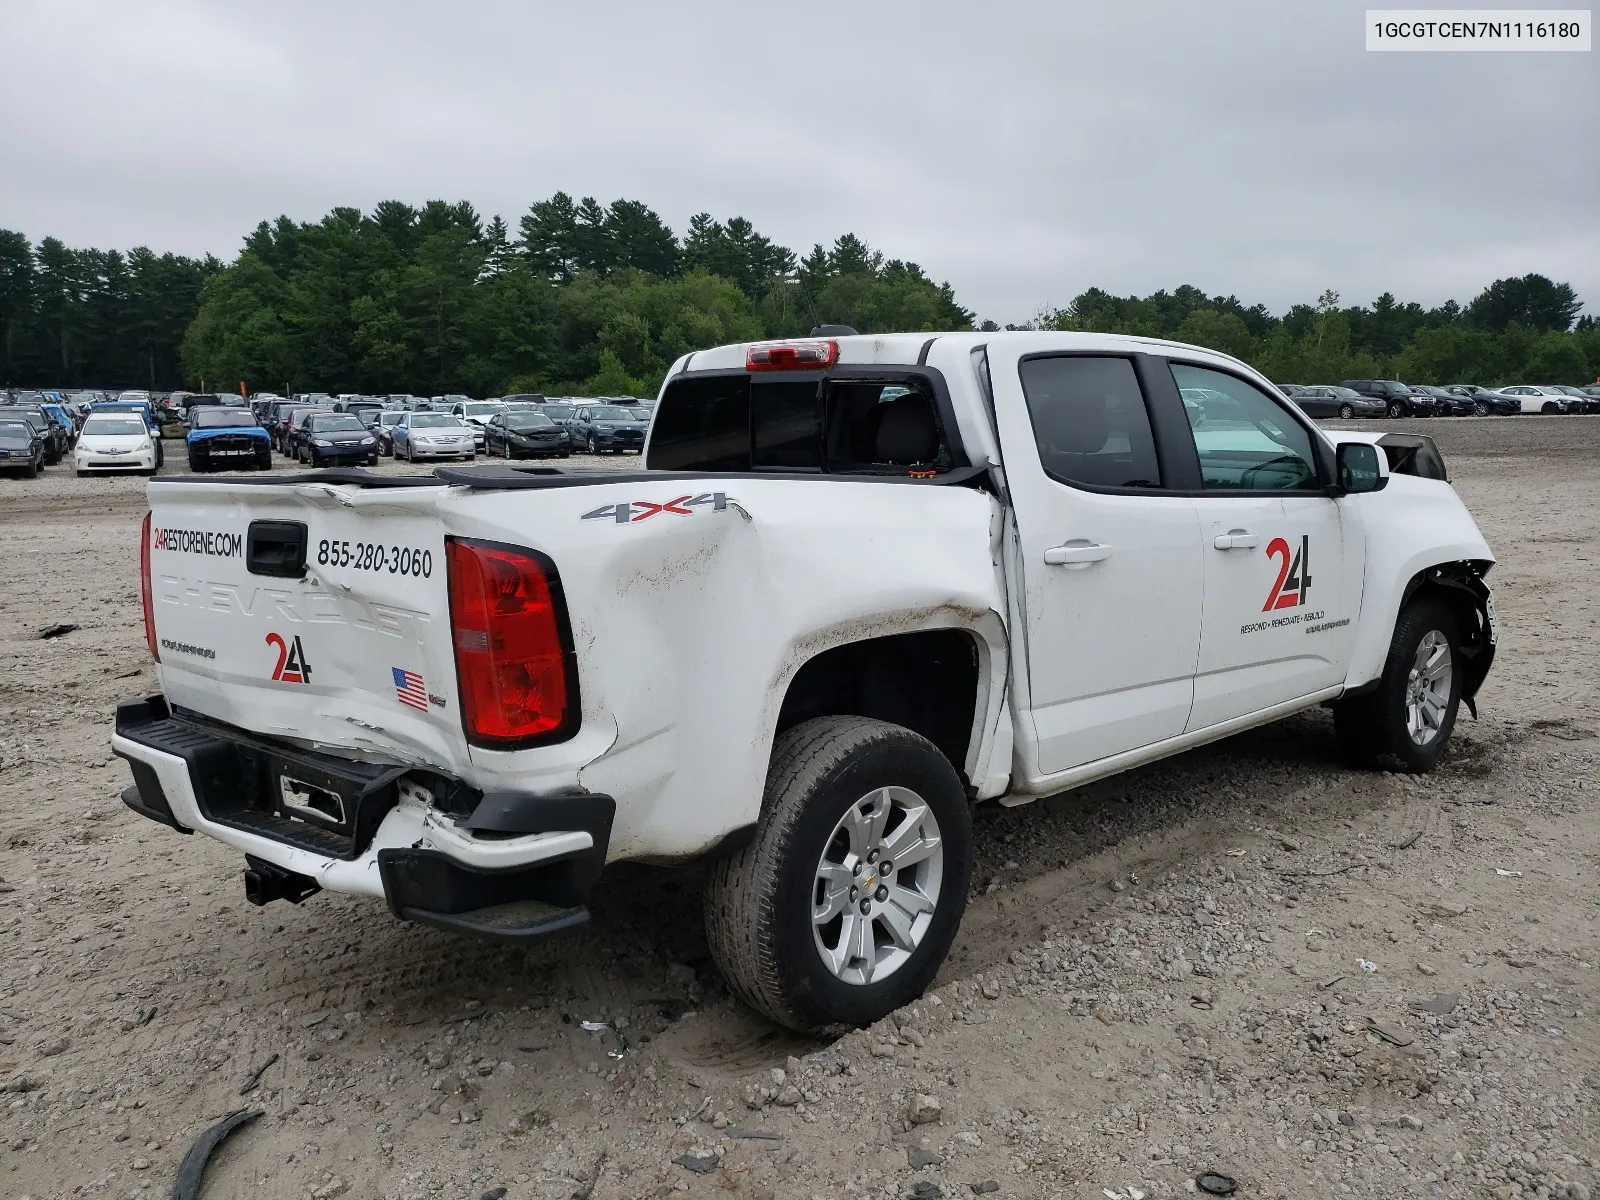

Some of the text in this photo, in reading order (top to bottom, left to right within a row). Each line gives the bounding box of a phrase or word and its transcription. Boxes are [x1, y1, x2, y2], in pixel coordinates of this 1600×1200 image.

[154, 527, 242, 558] 24RESTORENE.COM
[317, 539, 432, 578] 855-280-3060
[1261, 534, 1312, 612] 24
[1240, 621, 1268, 635] RESPOND
[265, 632, 313, 684] 24
